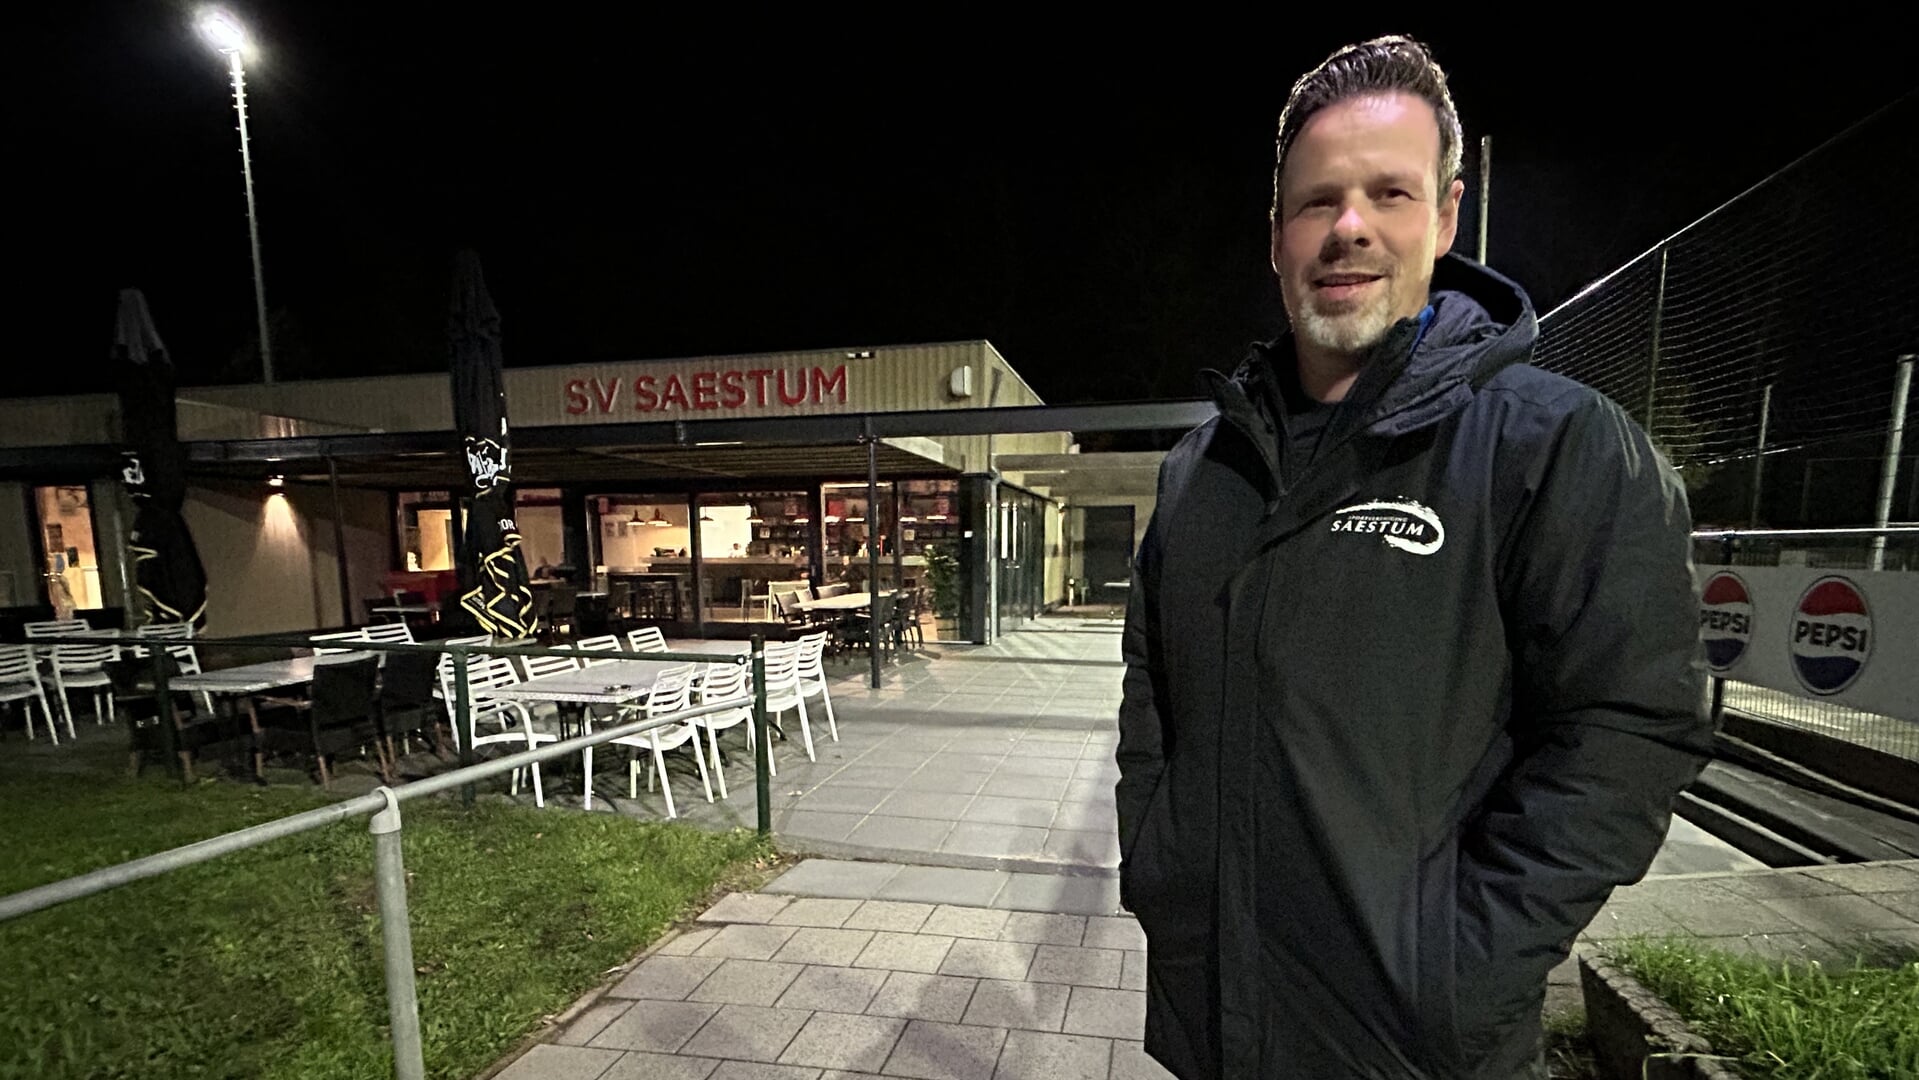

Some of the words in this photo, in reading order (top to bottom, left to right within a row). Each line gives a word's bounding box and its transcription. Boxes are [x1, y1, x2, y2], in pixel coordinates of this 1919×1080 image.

[564, 377, 621, 415] SV
[633, 365, 849, 412] SAESTUM
[1331, 520, 1424, 536] SAESTUM
[1701, 610, 1750, 634] PEPSI
[1795, 621, 1867, 653] PEPSI
